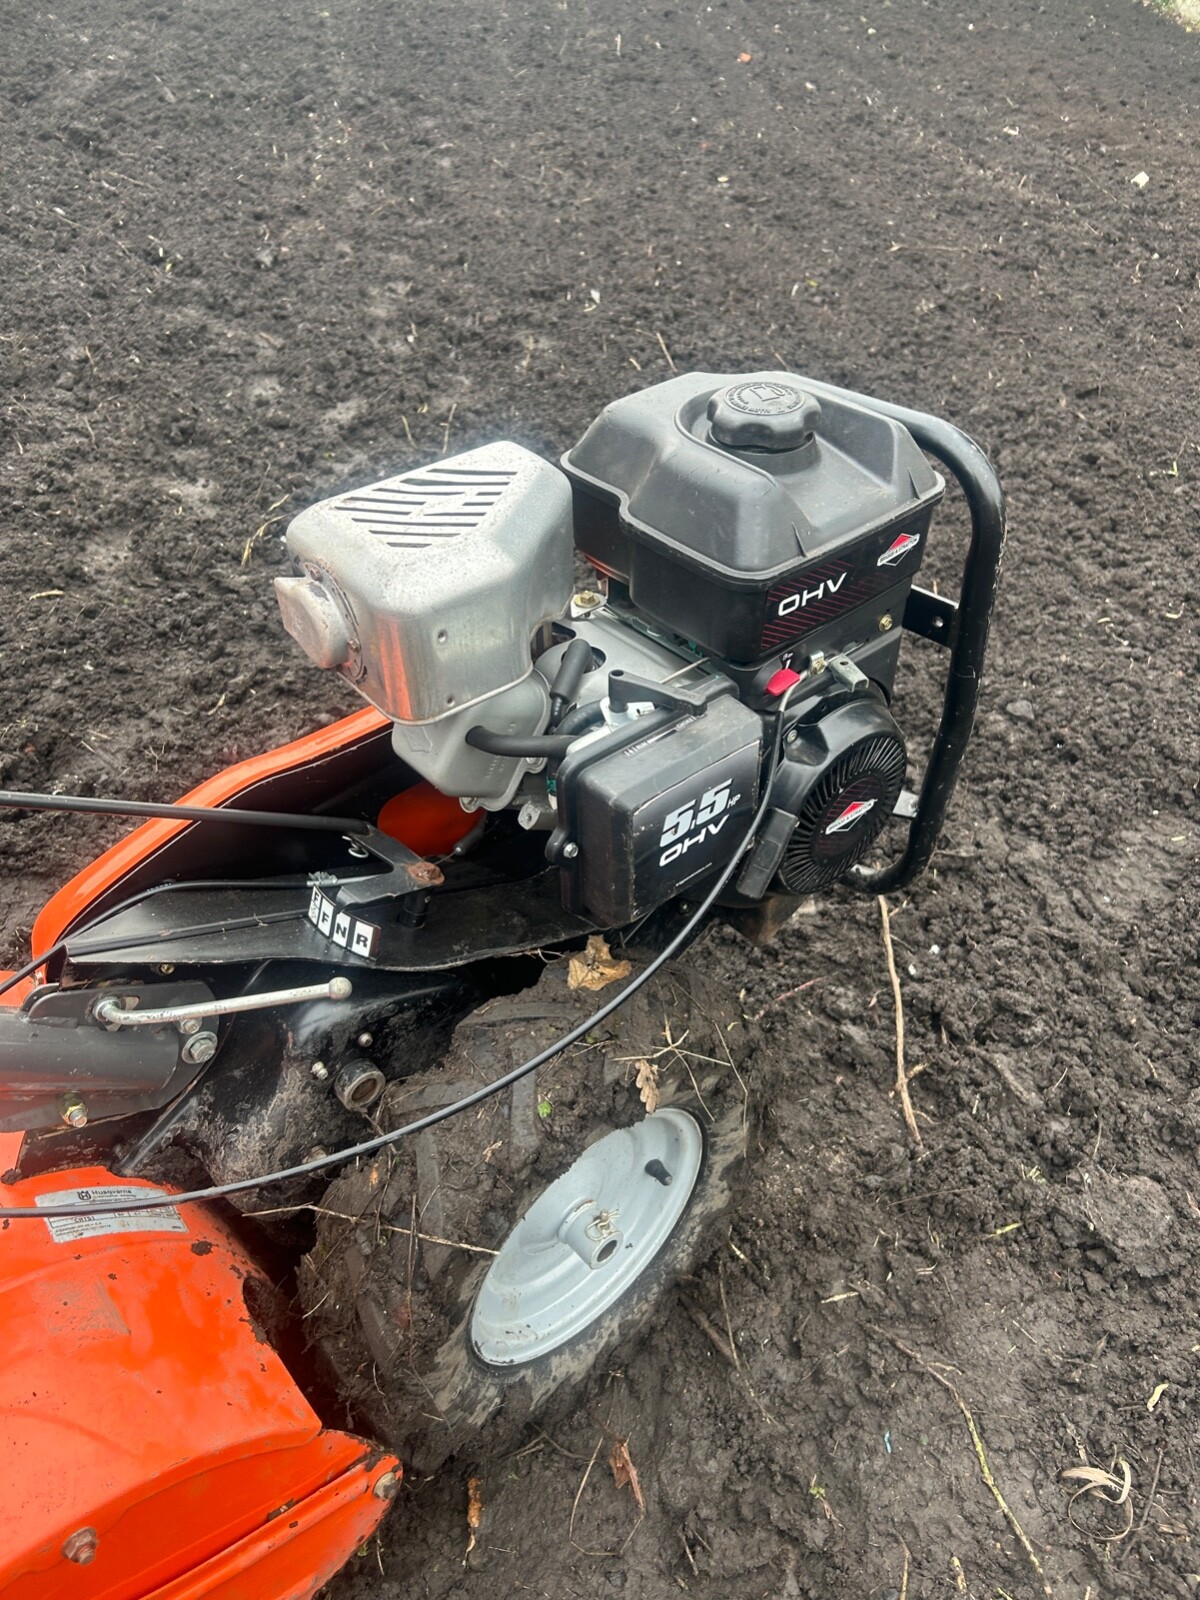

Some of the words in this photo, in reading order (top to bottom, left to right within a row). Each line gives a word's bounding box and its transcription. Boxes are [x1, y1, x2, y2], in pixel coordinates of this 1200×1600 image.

[778, 572, 847, 616] OHV
[659, 814, 730, 867] OHV
[321, 911, 330, 924] F
[336, 923, 347, 938] N
[356, 934, 369, 948] R
